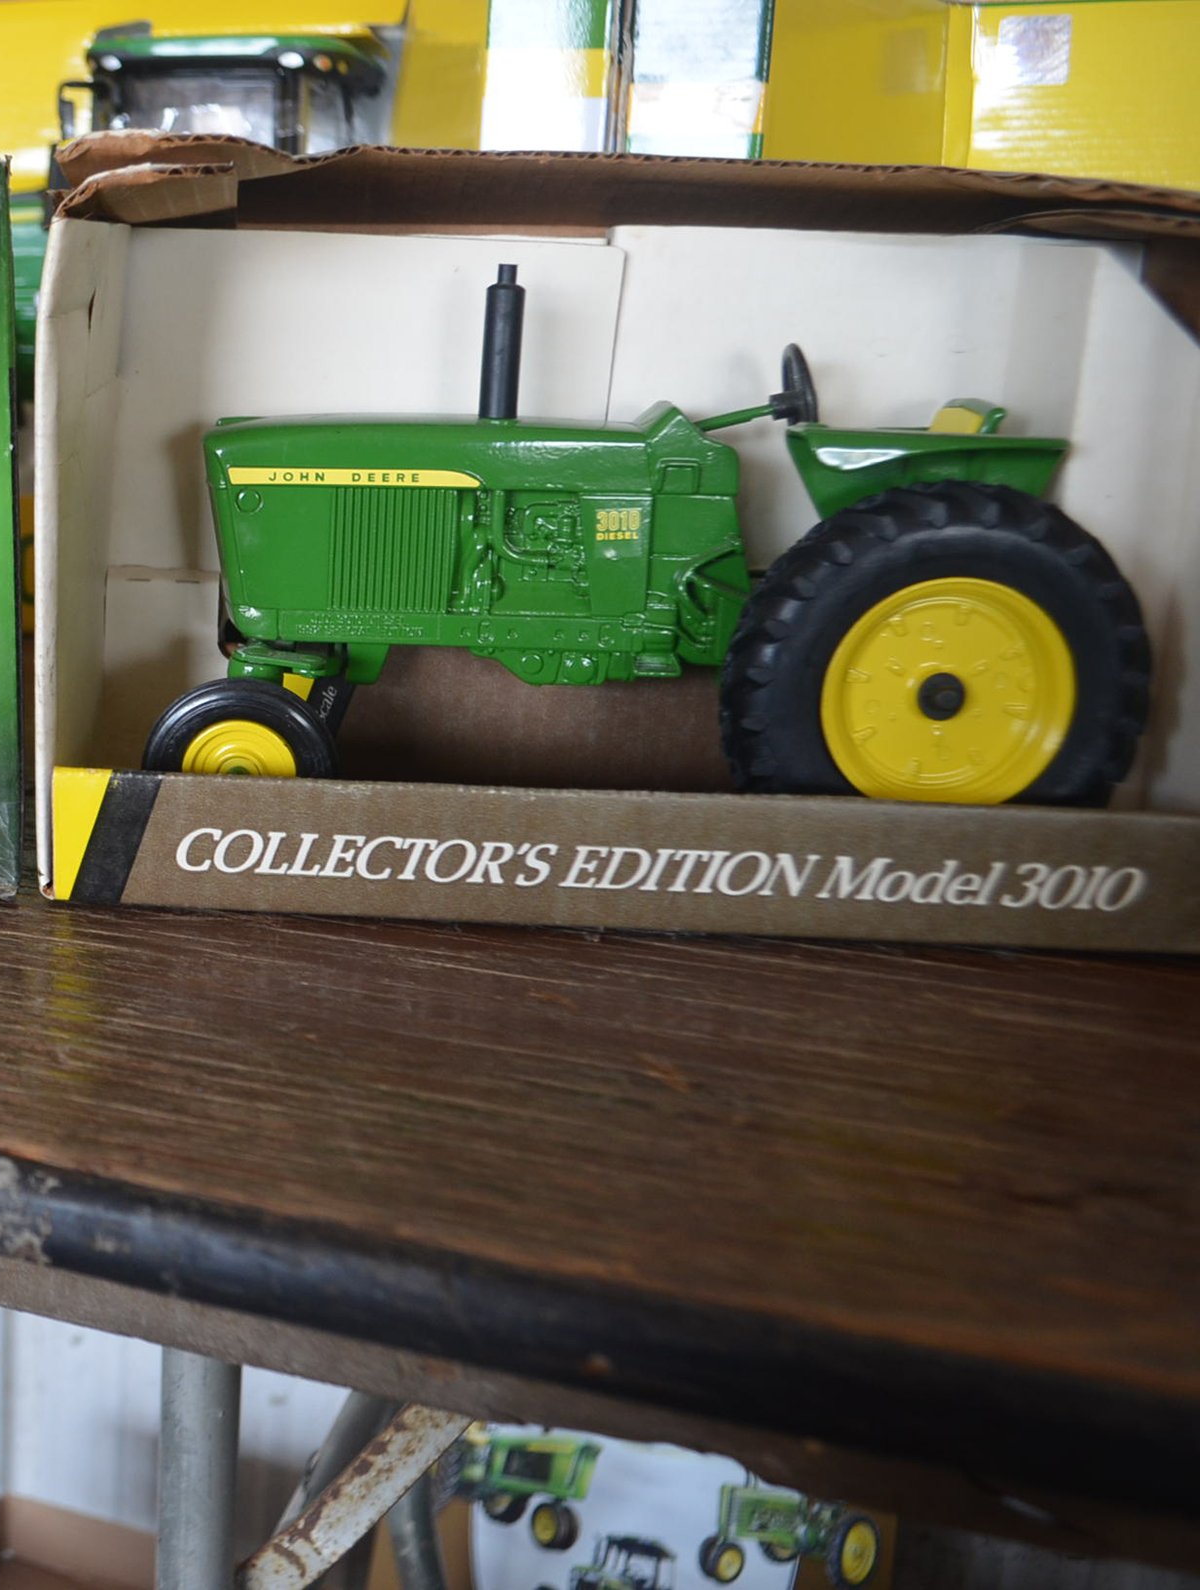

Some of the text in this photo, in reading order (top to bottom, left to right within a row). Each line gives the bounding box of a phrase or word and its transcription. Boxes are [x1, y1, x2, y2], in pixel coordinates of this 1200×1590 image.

[268, 471, 421, 484] JOHN DEERE
[595, 531, 640, 541] DIESEL
[175, 827, 1145, 912] COLLECTOR'S EDITION Model 3010
